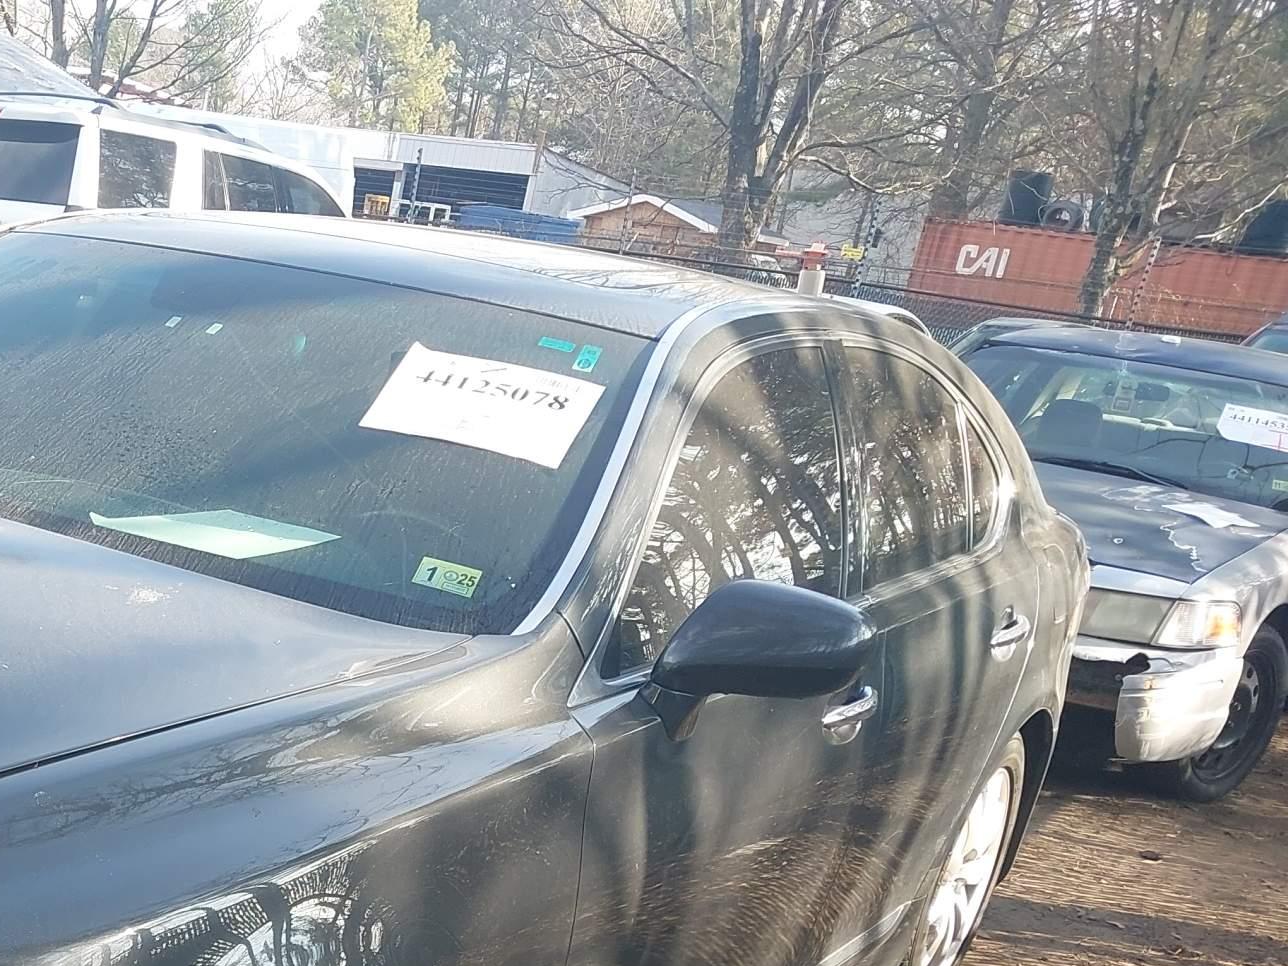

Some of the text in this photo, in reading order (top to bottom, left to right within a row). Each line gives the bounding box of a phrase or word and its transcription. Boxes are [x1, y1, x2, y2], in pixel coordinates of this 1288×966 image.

[955, 244, 1011, 279] CAI
[415, 369, 571, 411] 44125078
[456, 573, 478, 588] 25
